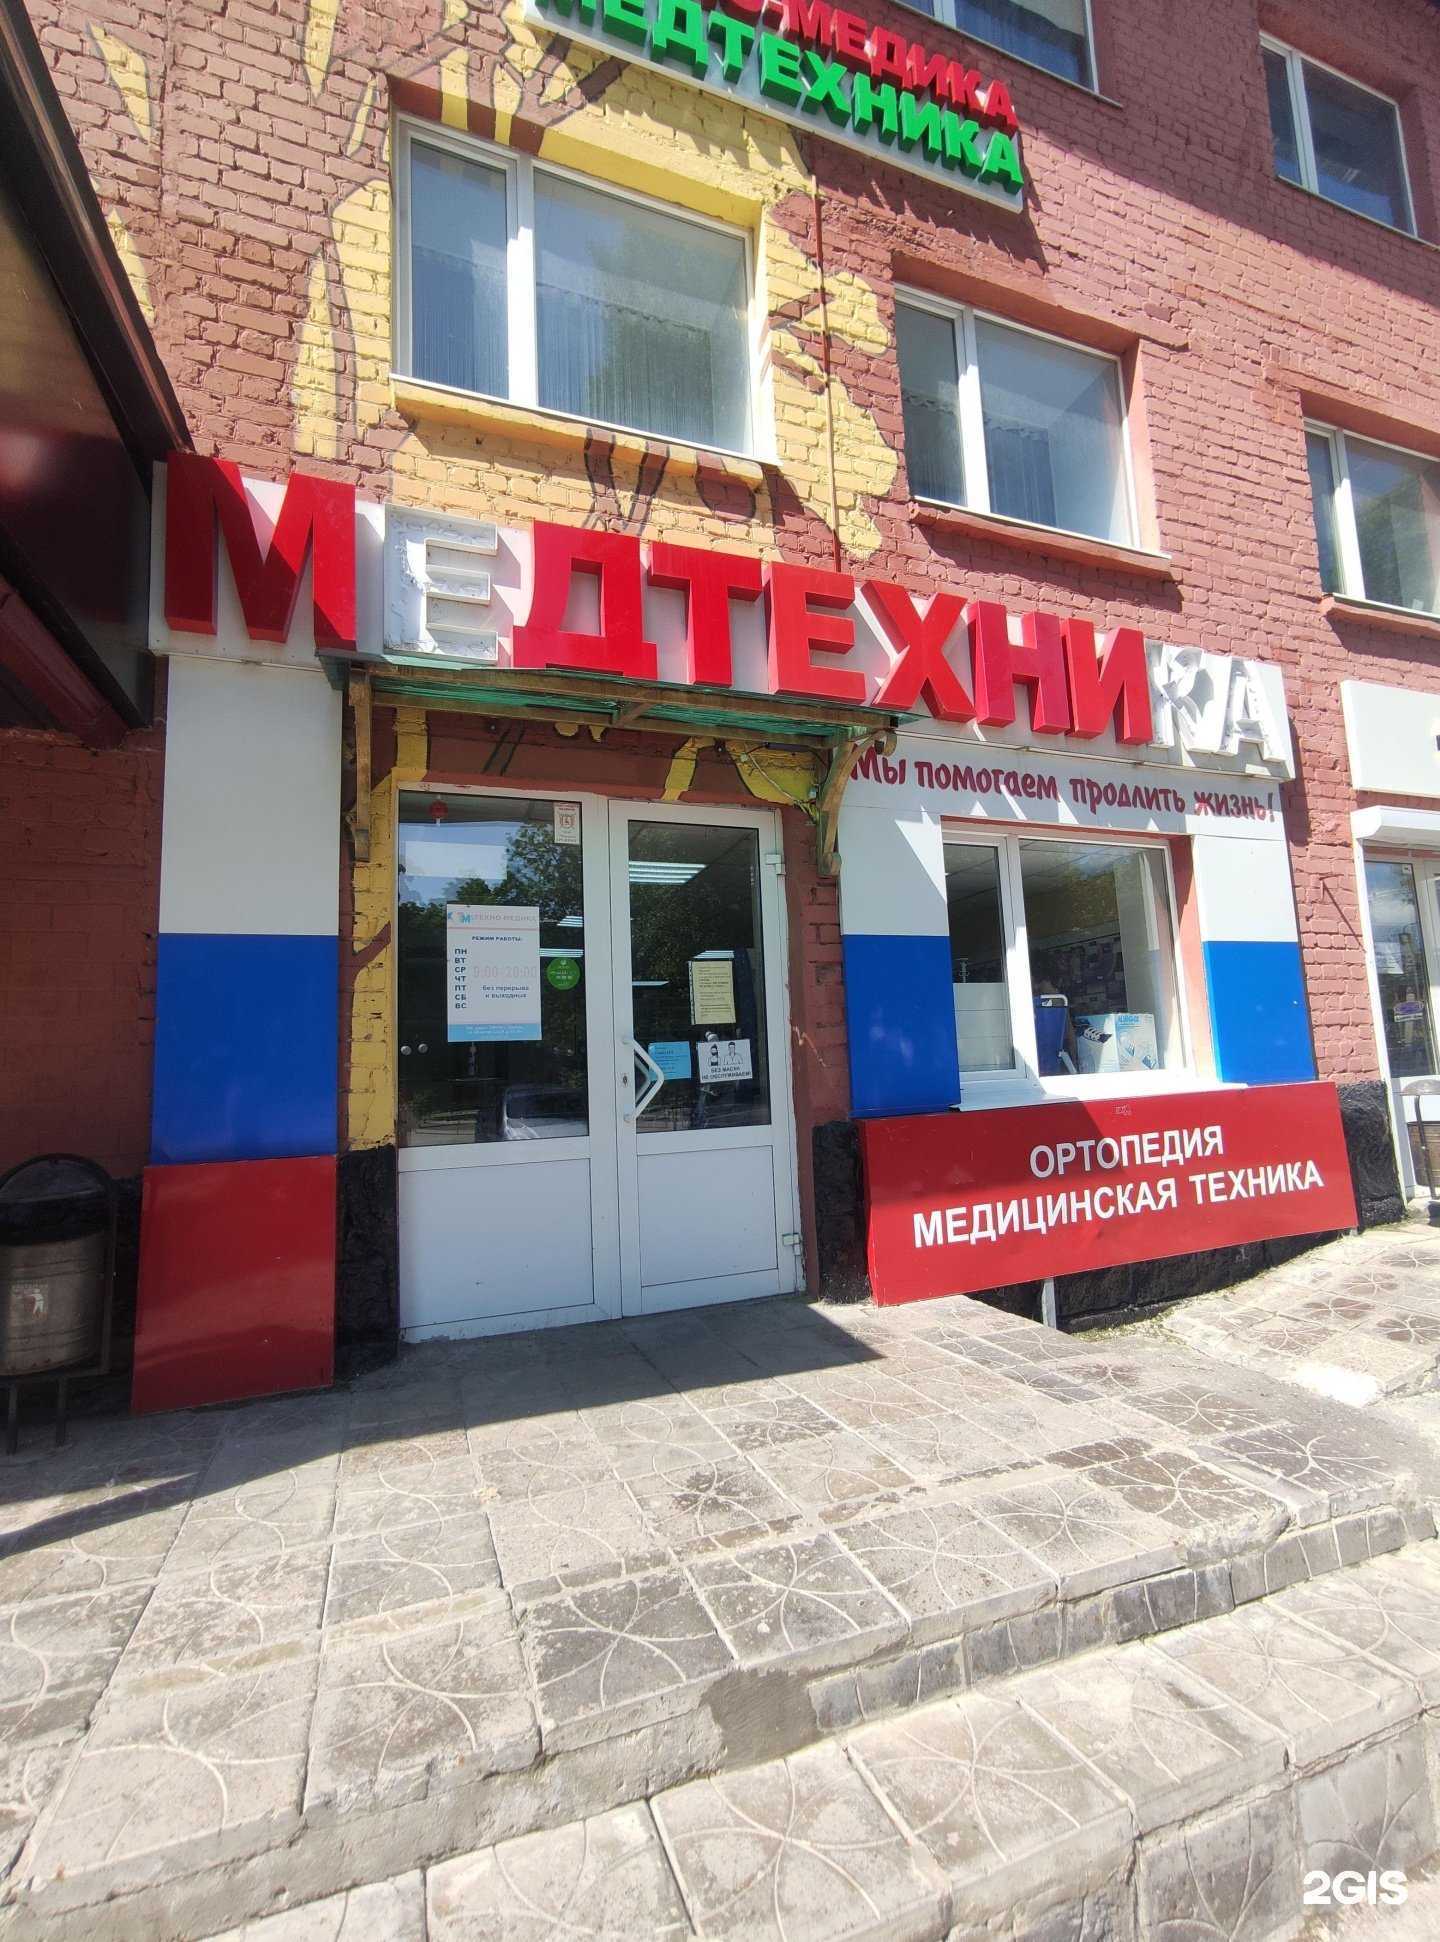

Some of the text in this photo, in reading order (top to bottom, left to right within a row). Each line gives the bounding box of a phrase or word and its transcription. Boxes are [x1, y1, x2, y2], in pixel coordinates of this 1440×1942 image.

[164, 453, 1286, 763] МЕДТЕХНИКА
[850, 744, 1275, 823] Мы помогаем продлить жизнь!
[1029, 1125, 1224, 1179] ОРТОПЕДИЯ
[912, 1159, 1324, 1249] МЕДИЦИНСКАЯ ТЕХНИКА
